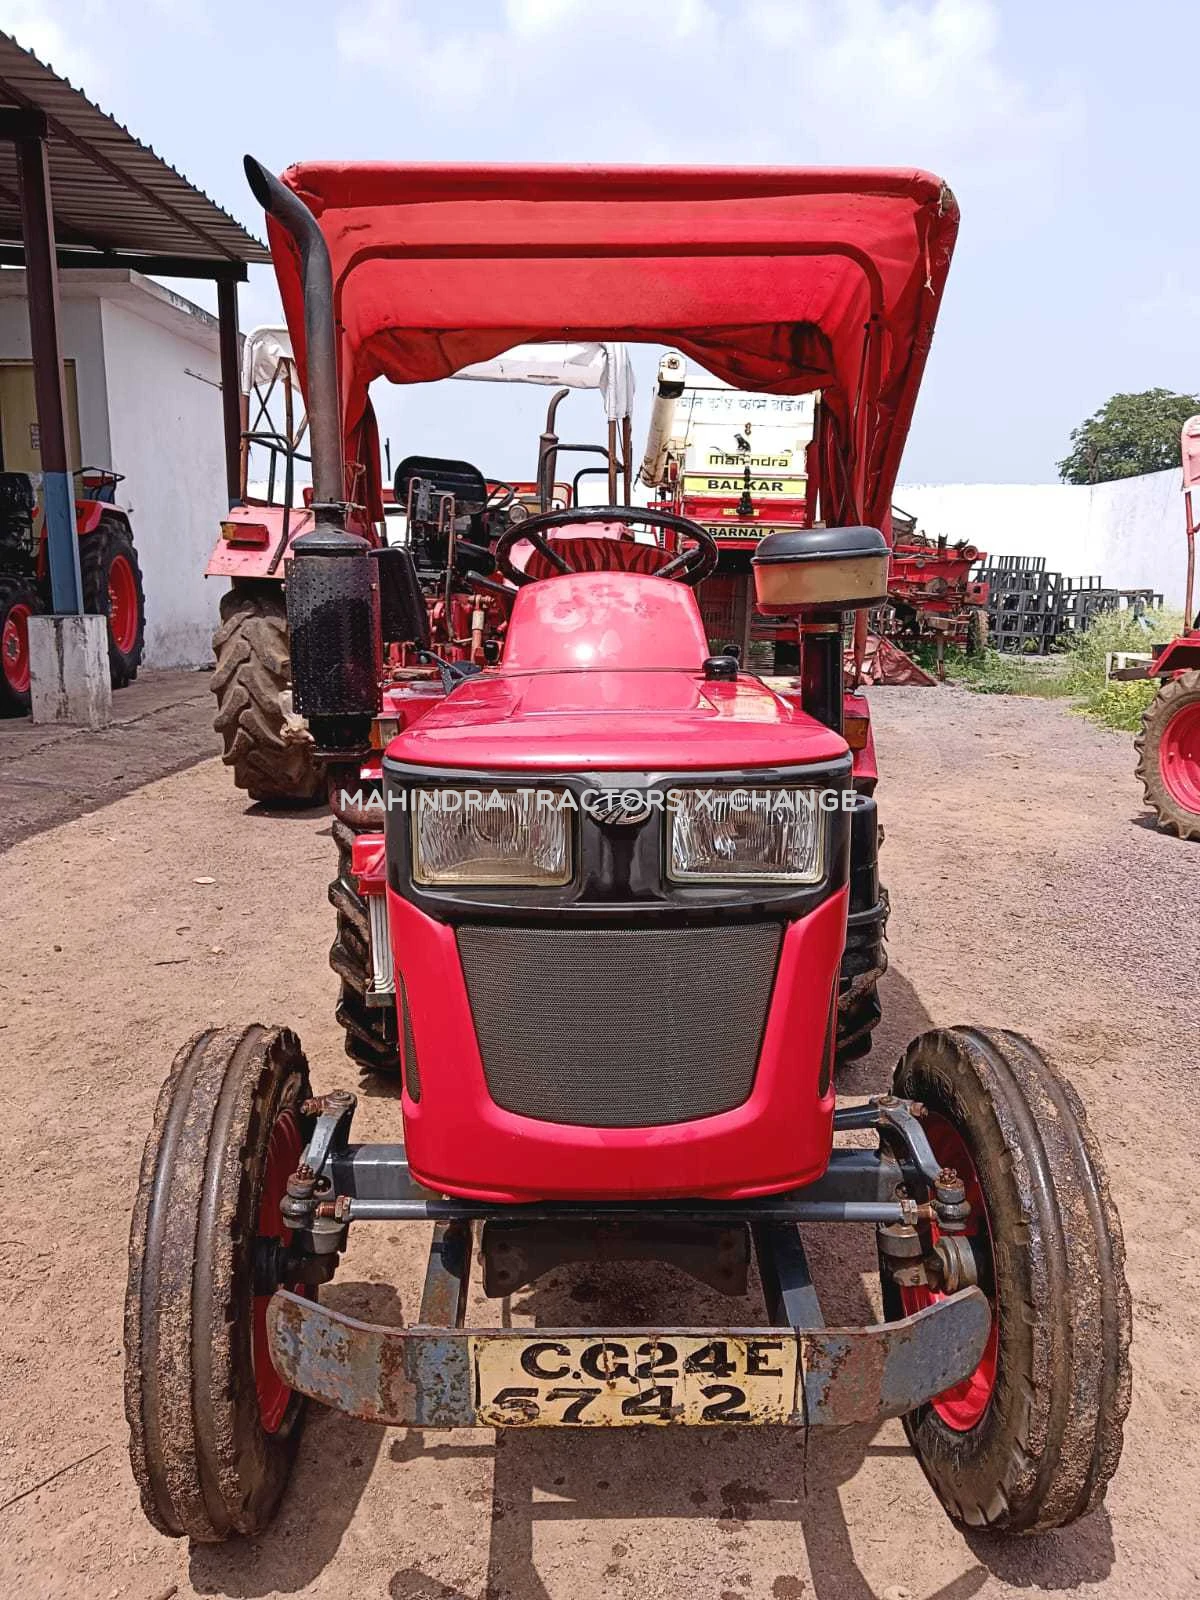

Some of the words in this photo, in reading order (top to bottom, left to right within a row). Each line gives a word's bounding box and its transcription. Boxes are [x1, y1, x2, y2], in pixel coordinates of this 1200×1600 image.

[709, 455, 789, 467] mahndra
[708, 480, 783, 491] BALKAR
[487, 1384, 752, 1424] 5742
